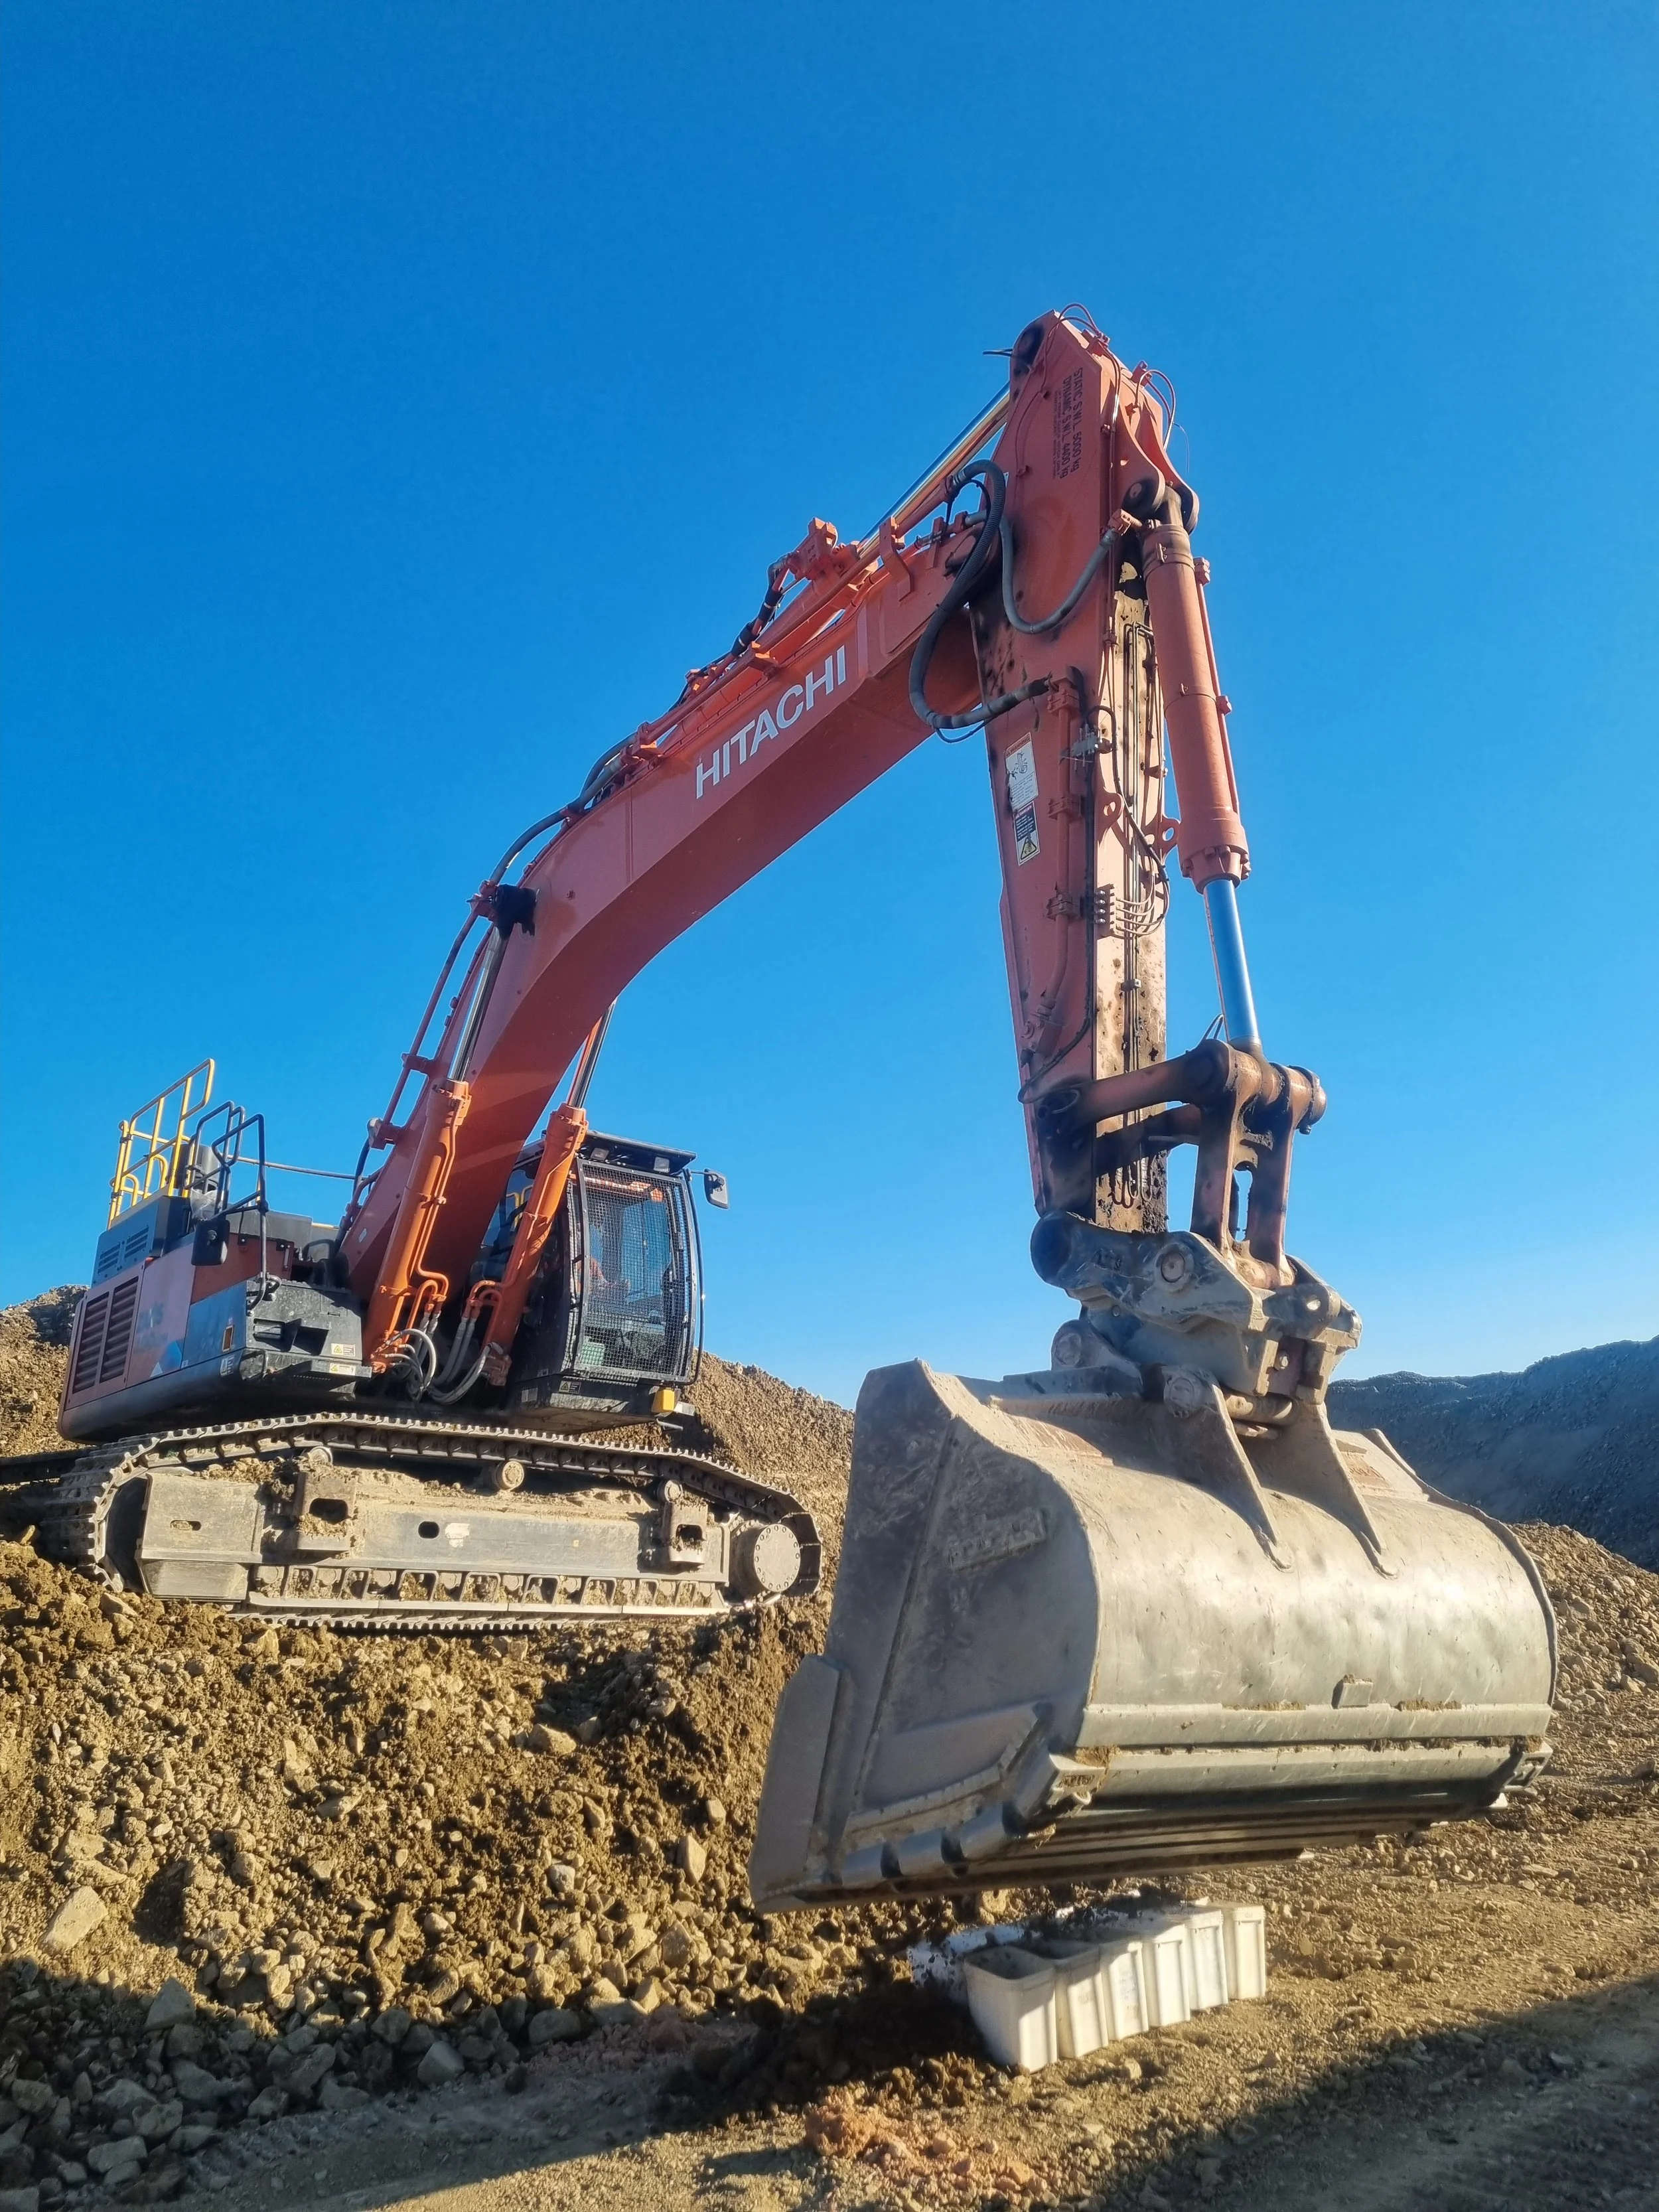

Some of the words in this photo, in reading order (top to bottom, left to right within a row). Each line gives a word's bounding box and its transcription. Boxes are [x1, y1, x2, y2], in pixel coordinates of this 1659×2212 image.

[1062, 376, 1072, 415] DYNAMIC
[1073, 368, 1083, 401] STATIC
[1070, 458, 1081, 473] kg
[696, 645, 846, 799] HITACHI
